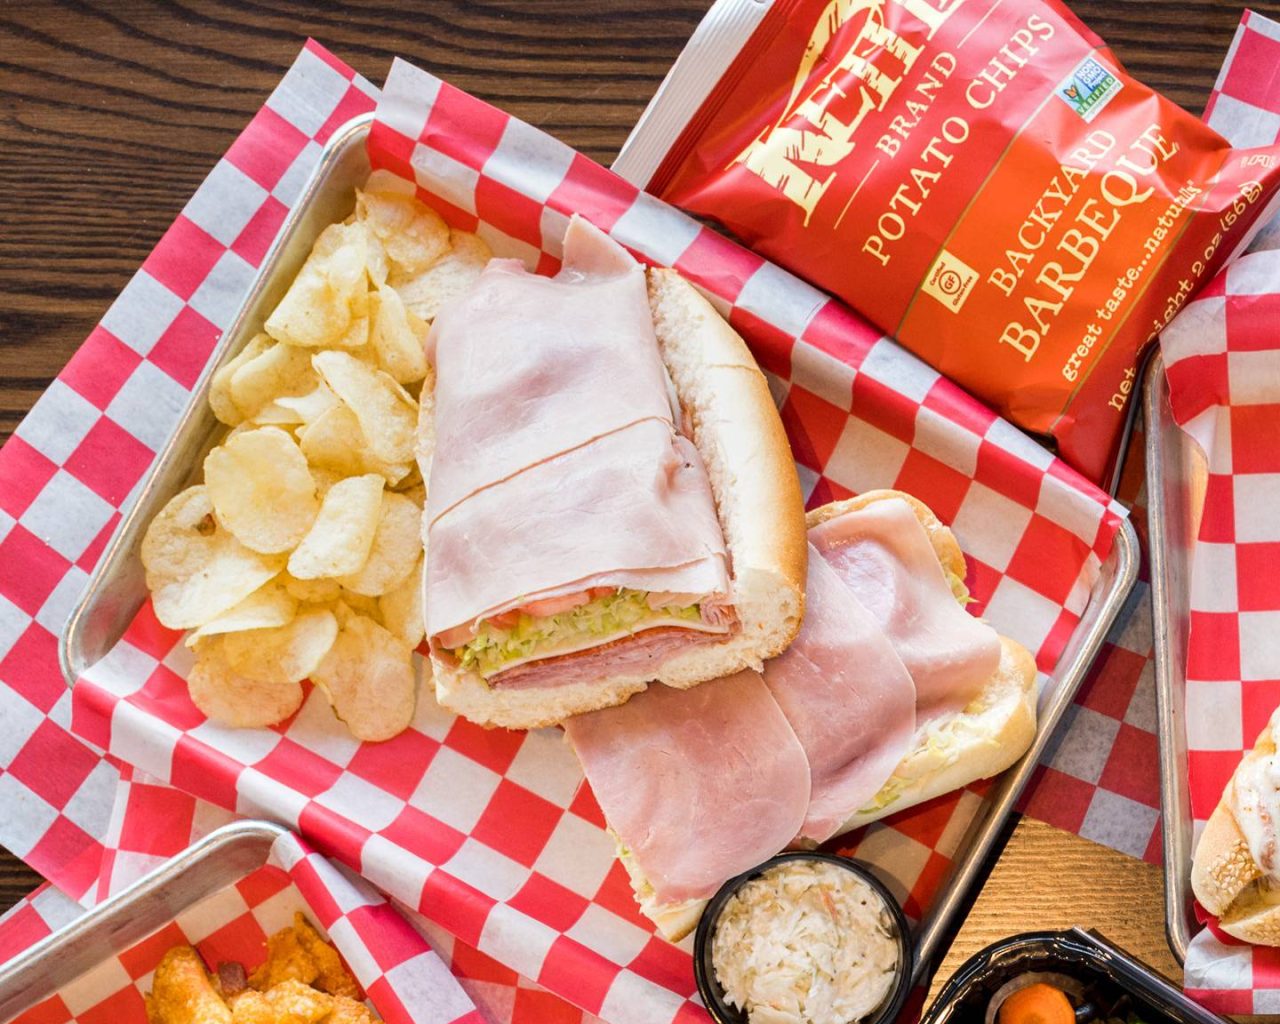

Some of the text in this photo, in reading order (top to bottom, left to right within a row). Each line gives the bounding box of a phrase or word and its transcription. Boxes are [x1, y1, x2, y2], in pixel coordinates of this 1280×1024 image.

[861, 13, 1056, 267] POTATO CHIPS
[875, 51, 957, 158] BRAND
[944, 275, 956, 290] GF
[987, 129, 1117, 297] BACKYARD
[999, 123, 1178, 363] BARBEQUE
[1062, 322, 1102, 383] great
[1108, 366, 1137, 412] net
[1191, 260, 1206, 278] 2
[1203, 231, 1223, 260] oz
